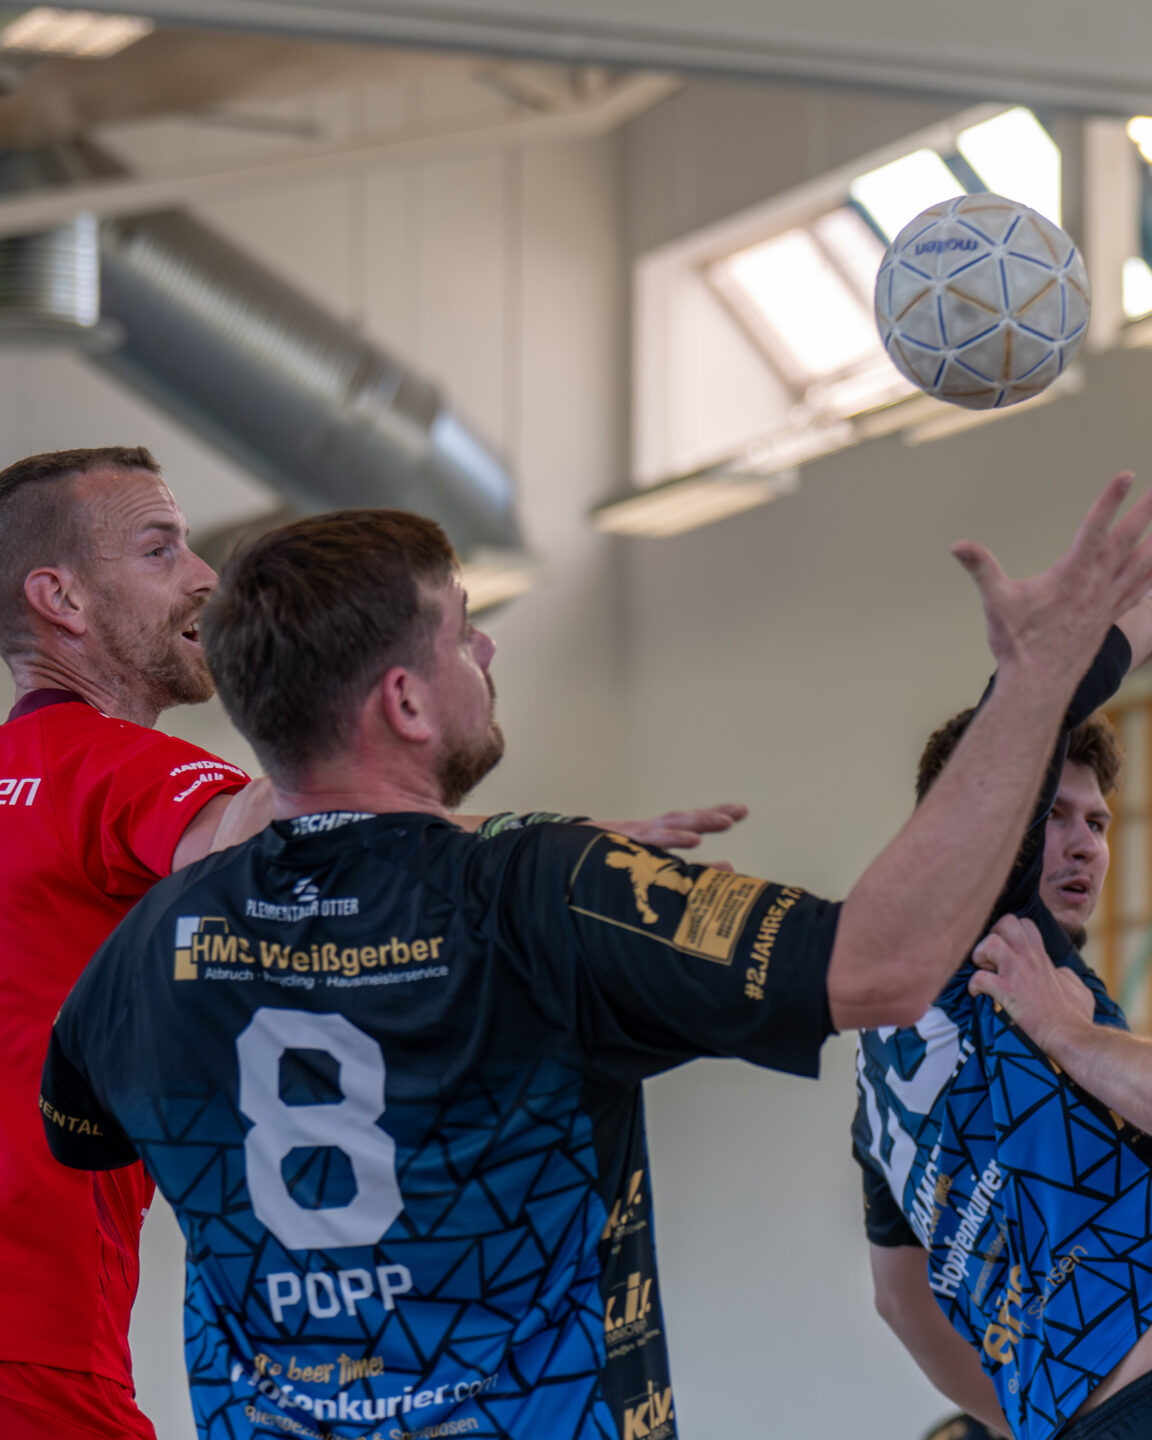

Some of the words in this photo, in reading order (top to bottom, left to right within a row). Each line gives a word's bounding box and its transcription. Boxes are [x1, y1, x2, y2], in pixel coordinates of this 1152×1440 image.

[321, 897, 360, 917] OTTER
[192, 934, 256, 964] HMS
[259, 935, 444, 977] Weißgerber
[326, 964, 449, 988] Hausmeisterservice
[236, 1006, 402, 1251] 8
[930, 1158, 1003, 1299] Hopfenkurier
[266, 1263, 414, 1323] POPP
[286, 1355, 335, 1385] beer
